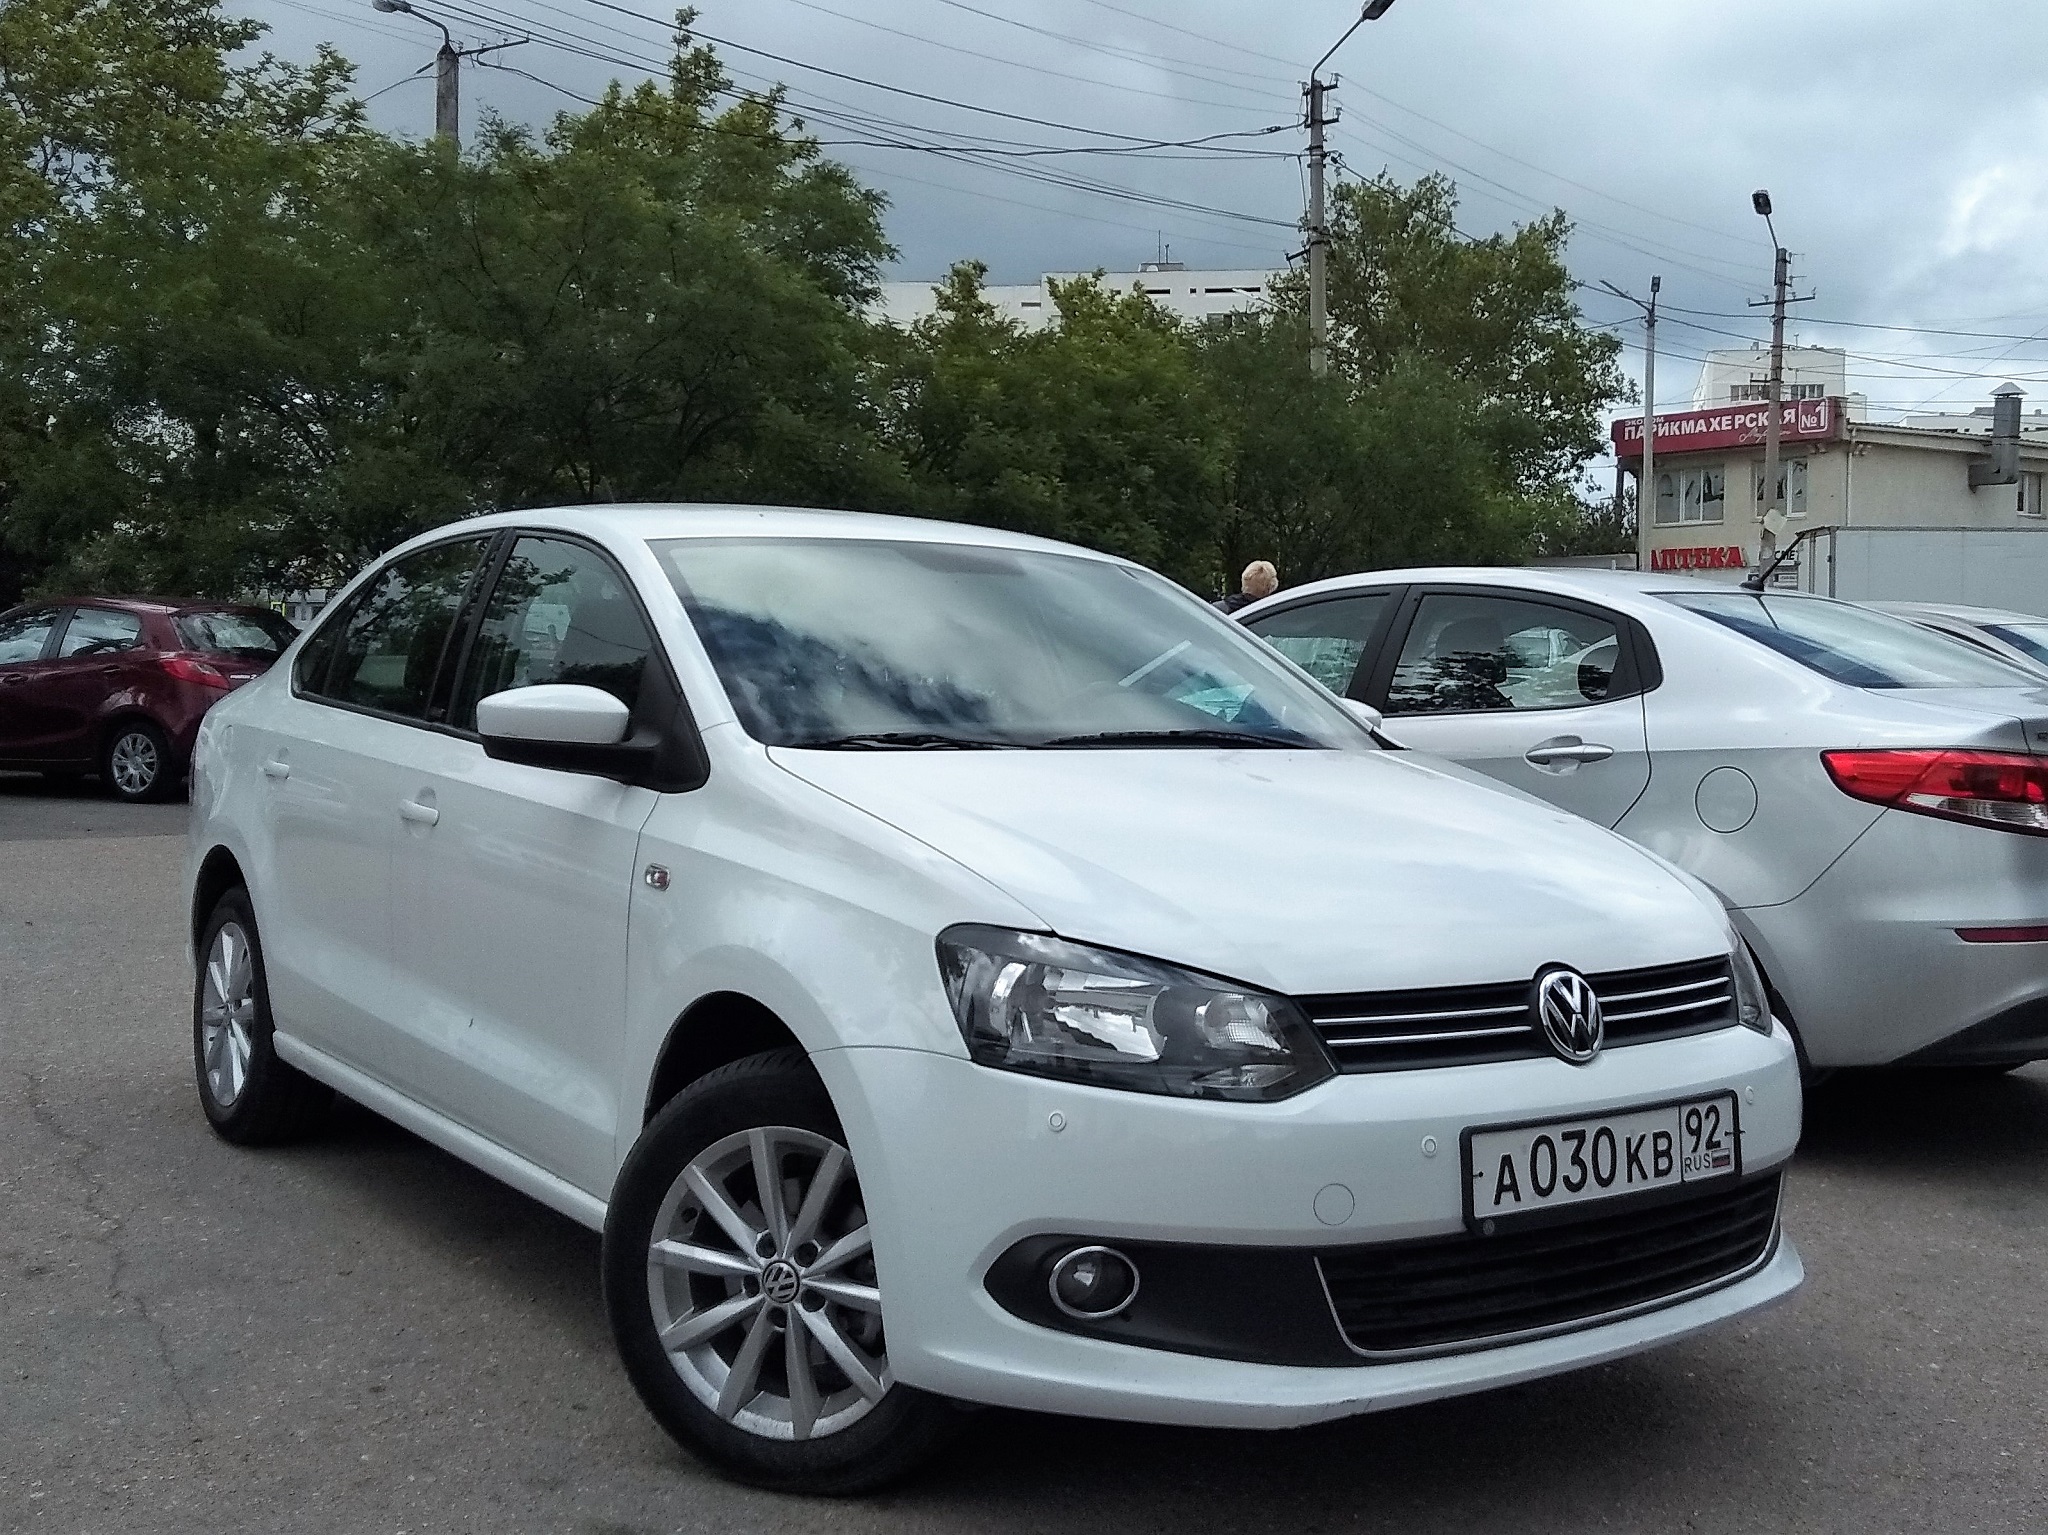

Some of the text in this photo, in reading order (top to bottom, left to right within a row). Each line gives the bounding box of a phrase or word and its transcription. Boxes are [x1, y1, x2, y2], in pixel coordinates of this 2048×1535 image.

[1624, 408, 1797, 441] ПАИКМАХЕРСКЯ
[1625, 417, 1664, 426] ЭКОМ
[1685, 1104, 1721, 1153] 92
[1684, 1152, 1711, 1173] RUS
